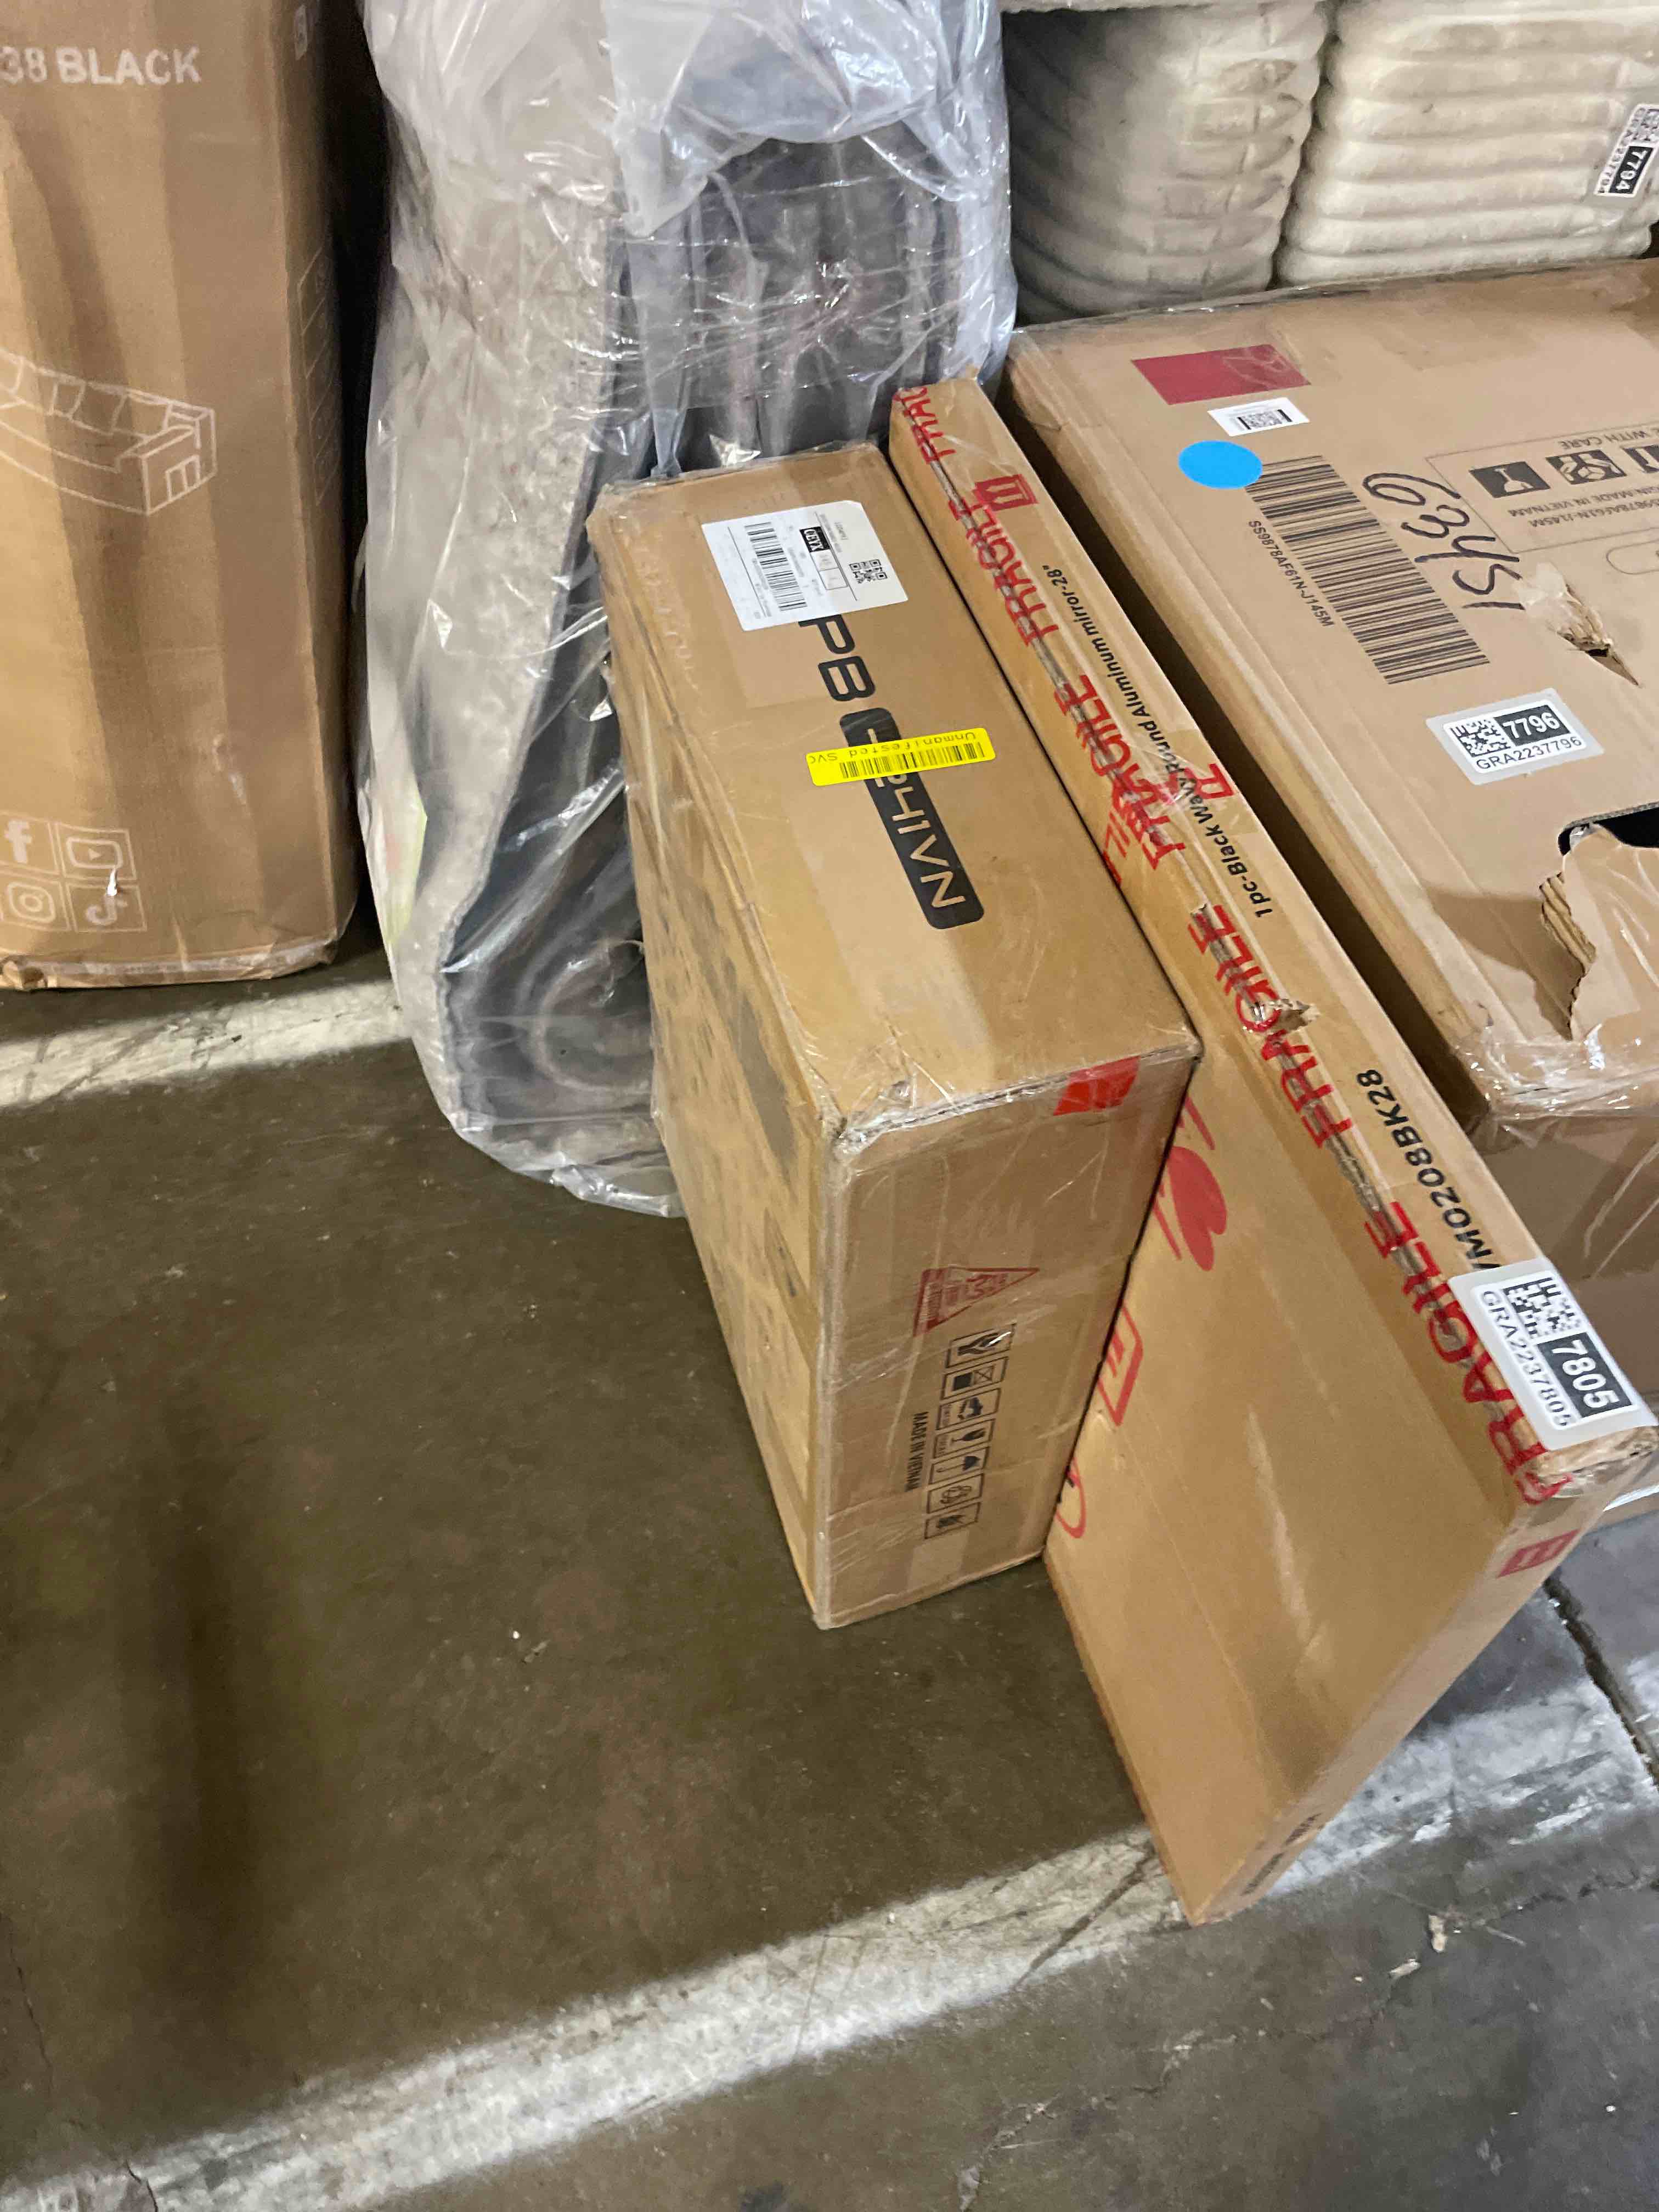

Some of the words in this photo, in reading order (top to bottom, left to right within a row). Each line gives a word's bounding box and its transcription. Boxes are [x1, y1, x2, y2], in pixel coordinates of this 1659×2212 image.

[55, 45, 202, 85] BLACK
[947, 496, 1059, 646] FRAGILE
[1091, 637, 1151, 718] Aluminum
[850, 731, 977, 758] Unmanifested
[1476, 736, 1582, 769] GRA2237796
[1503, 712, 1560, 739] 7796
[1188, 905, 1352, 1148] FRAGILE
[1364, 1201, 1573, 1504] FRAGILE
[1482, 1290, 1576, 1426] GRA2237805
[1551, 1339, 1620, 1409] 7805
